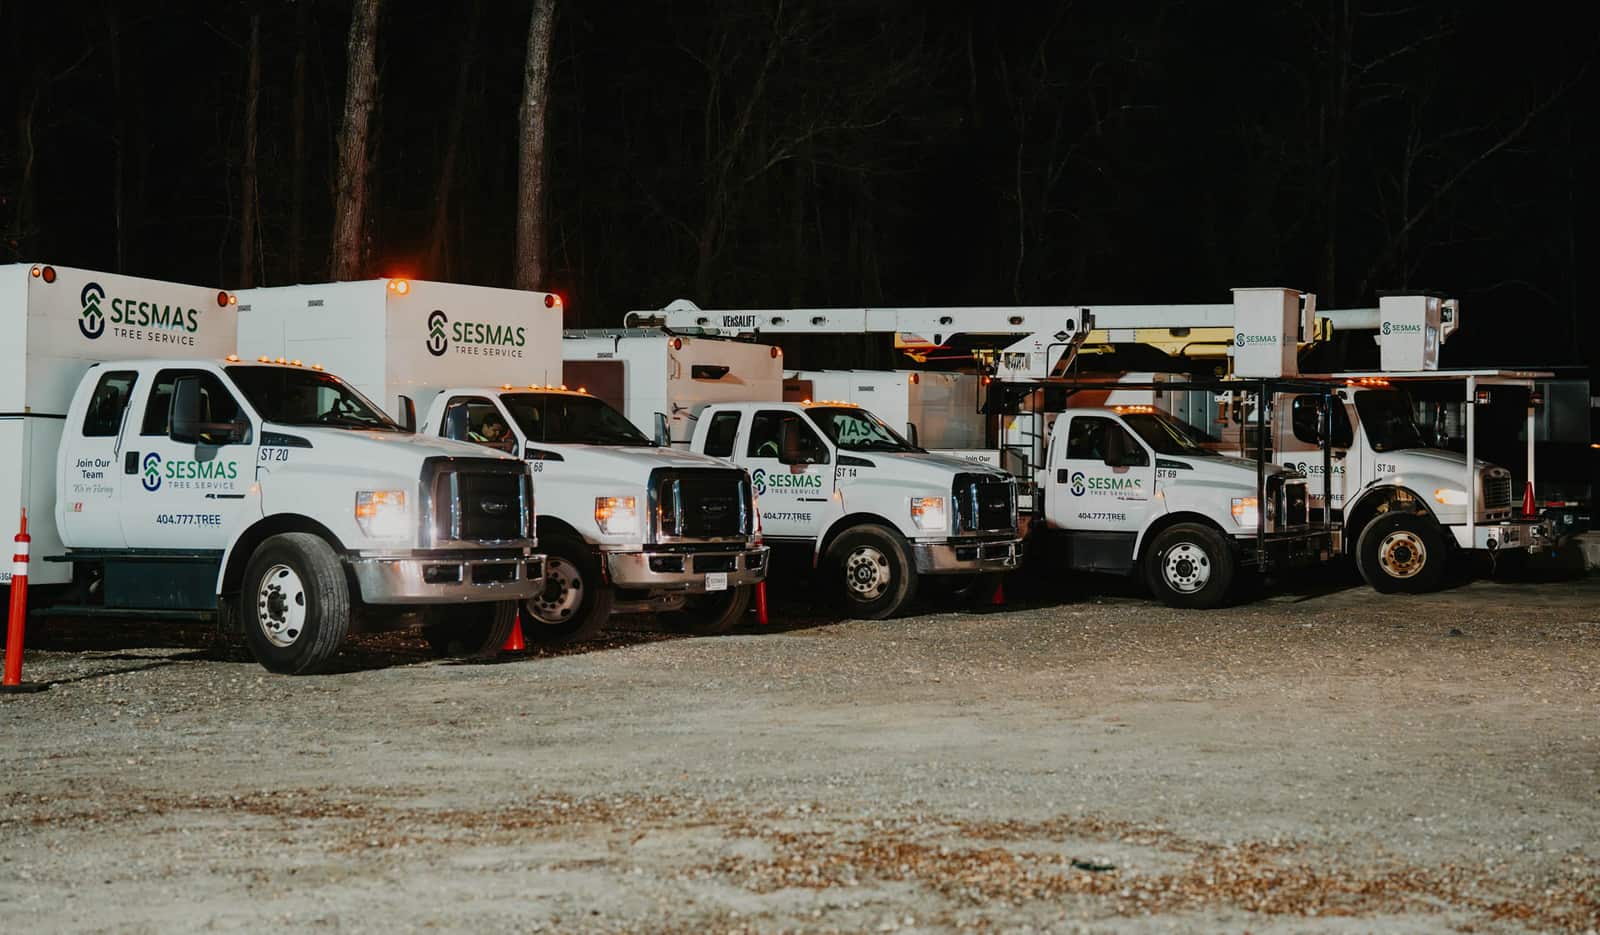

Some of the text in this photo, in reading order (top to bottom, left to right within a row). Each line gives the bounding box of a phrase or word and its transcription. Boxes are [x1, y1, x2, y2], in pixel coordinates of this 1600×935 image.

[110, 297, 198, 333] SESMAS
[1392, 324, 1421, 332] SESMAS
[113, 327, 195, 346] TREE SERVICE
[452, 321, 525, 347] SESMAS
[1246, 335, 1277, 343] SESMAS
[455, 346, 523, 358] TREE SERVICE
[260, 448, 289, 462] ST 20
[76, 458, 111, 468] Join Our
[533, 461, 544, 472] 68
[1377, 463, 1396, 473] ST 38
[82, 470, 104, 479] Team
[165, 461, 237, 480] SESMAS
[836, 467, 857, 478] ST 14
[1157, 469, 1177, 479] ST 69
[1308, 465, 1346, 474] SESAS
[168, 481, 235, 490] TREE SERVICE
[768, 473, 822, 488] SESMAS
[1088, 477, 1142, 489] SESMAS
[156, 514, 221, 525] 404.777.TREE
[763, 512, 812, 521] 404.777.TREE
[1078, 512, 1126, 521] 404.777.TREE
